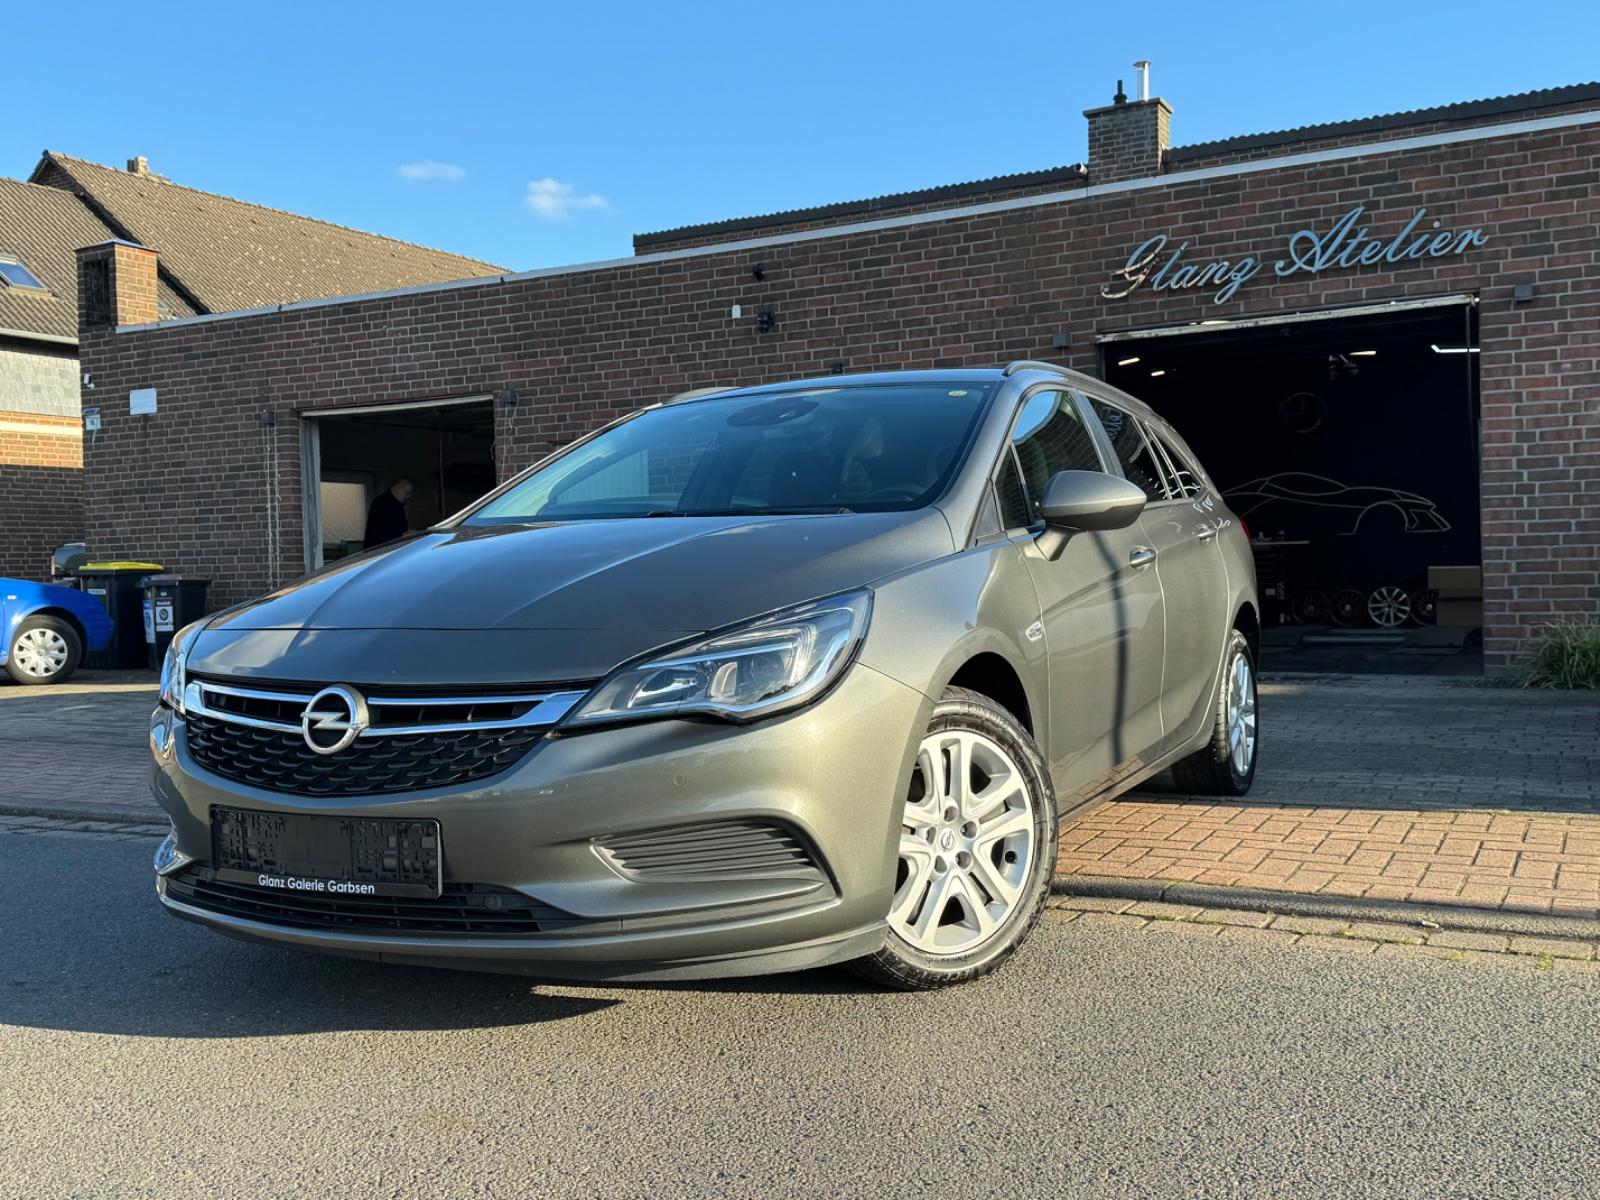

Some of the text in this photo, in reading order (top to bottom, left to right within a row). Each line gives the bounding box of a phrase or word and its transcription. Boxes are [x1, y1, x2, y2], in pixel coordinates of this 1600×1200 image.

[1100, 206, 1490, 305] Glanz Atelier
[258, 874, 375, 894] Glanz Galerie Garbsen
